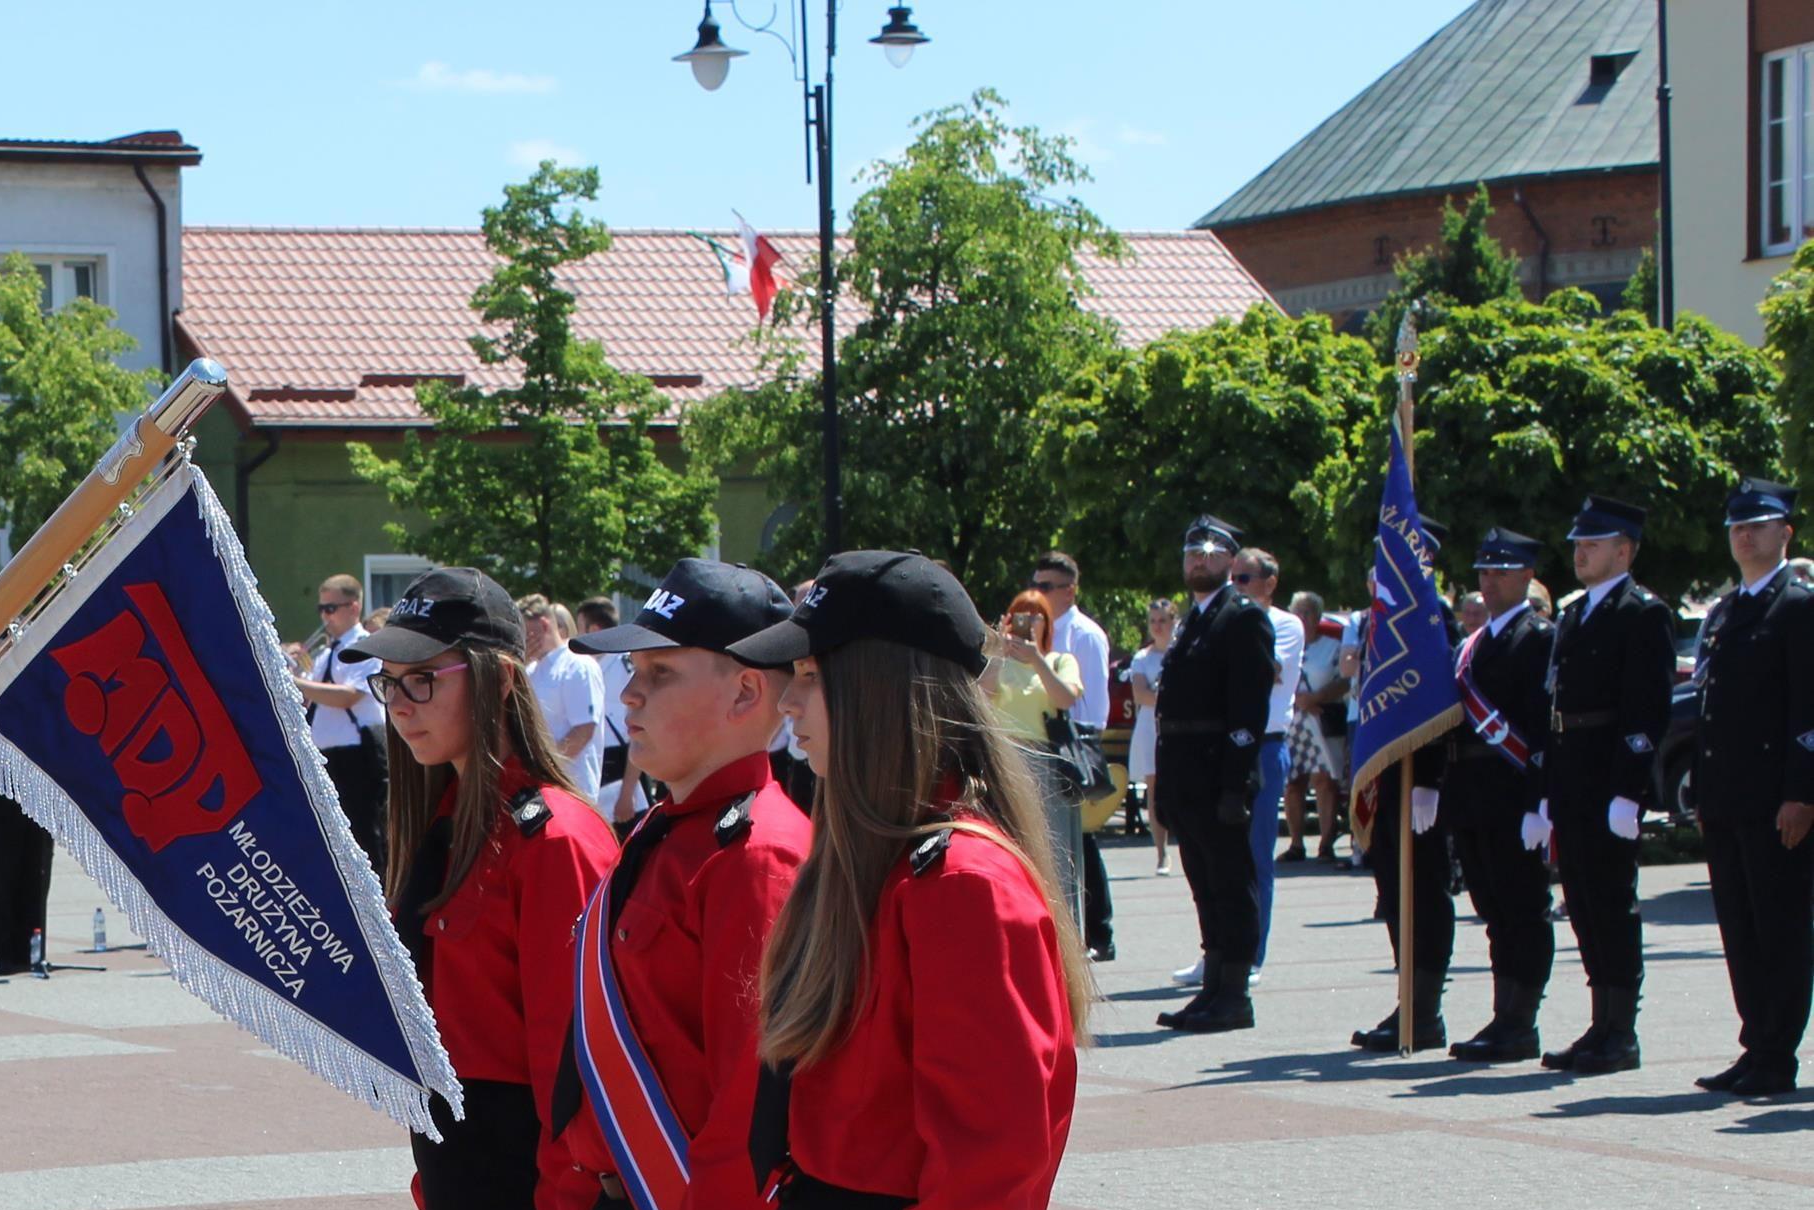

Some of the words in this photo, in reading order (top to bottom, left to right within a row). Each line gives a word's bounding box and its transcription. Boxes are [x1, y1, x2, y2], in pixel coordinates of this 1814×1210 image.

[49, 581, 264, 854] MDP
[1360, 669, 1421, 726] LIPNO
[196, 862, 306, 999] POŻARNICZA
[227, 863, 313, 966] DRUŻYNA
[228, 820, 354, 974] MŁODZIEŻOWA
